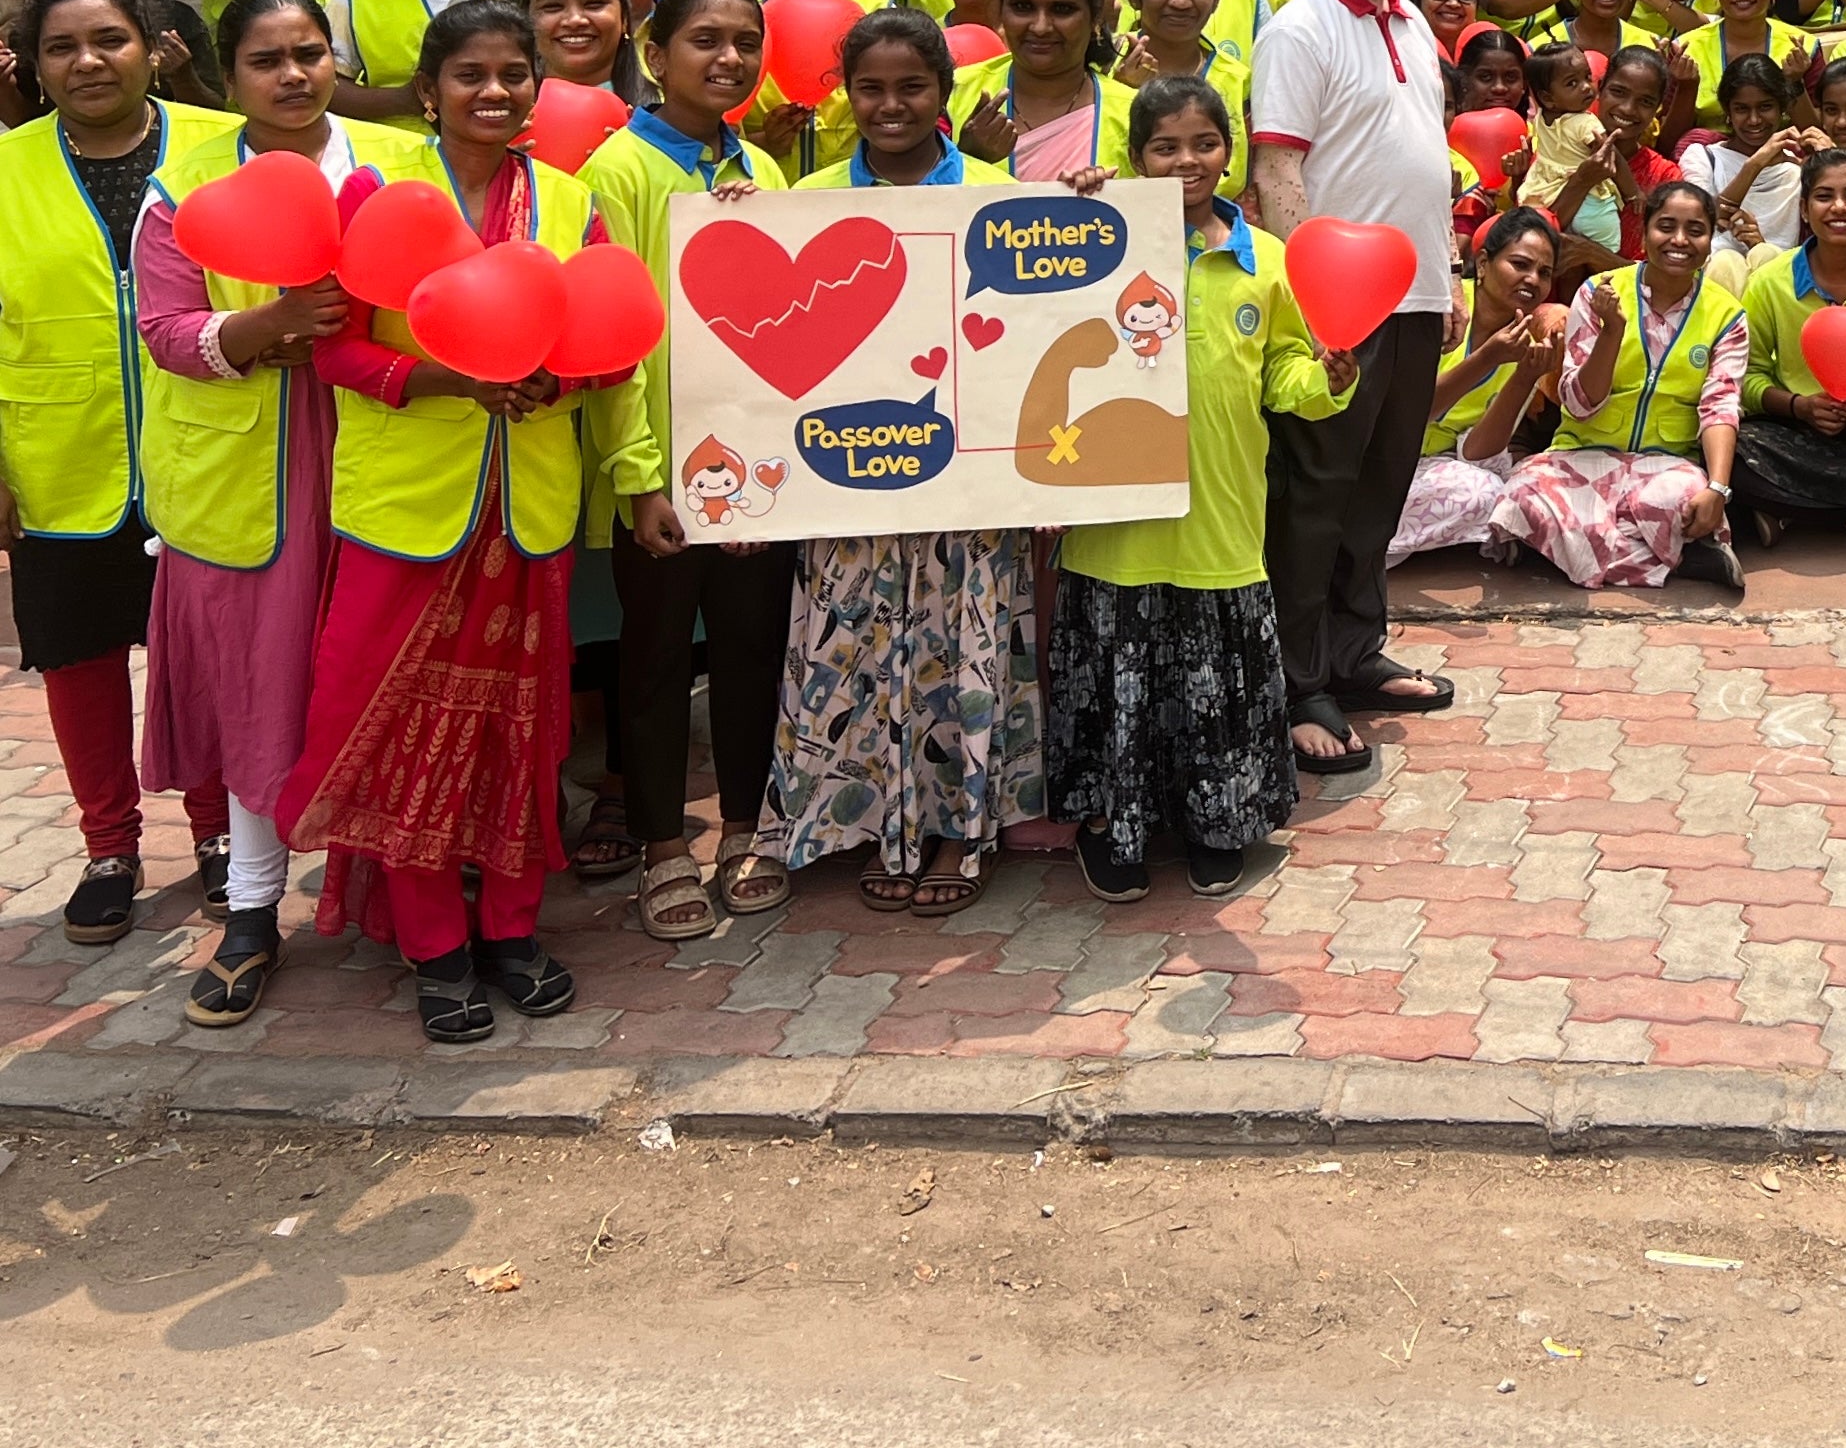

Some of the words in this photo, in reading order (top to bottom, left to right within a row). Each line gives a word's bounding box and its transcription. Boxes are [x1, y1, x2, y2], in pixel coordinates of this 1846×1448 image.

[985, 217, 1115, 251] Mother's
[1015, 251, 1087, 280] Love
[803, 418, 941, 450] Passover
[847, 448, 920, 478] Love
